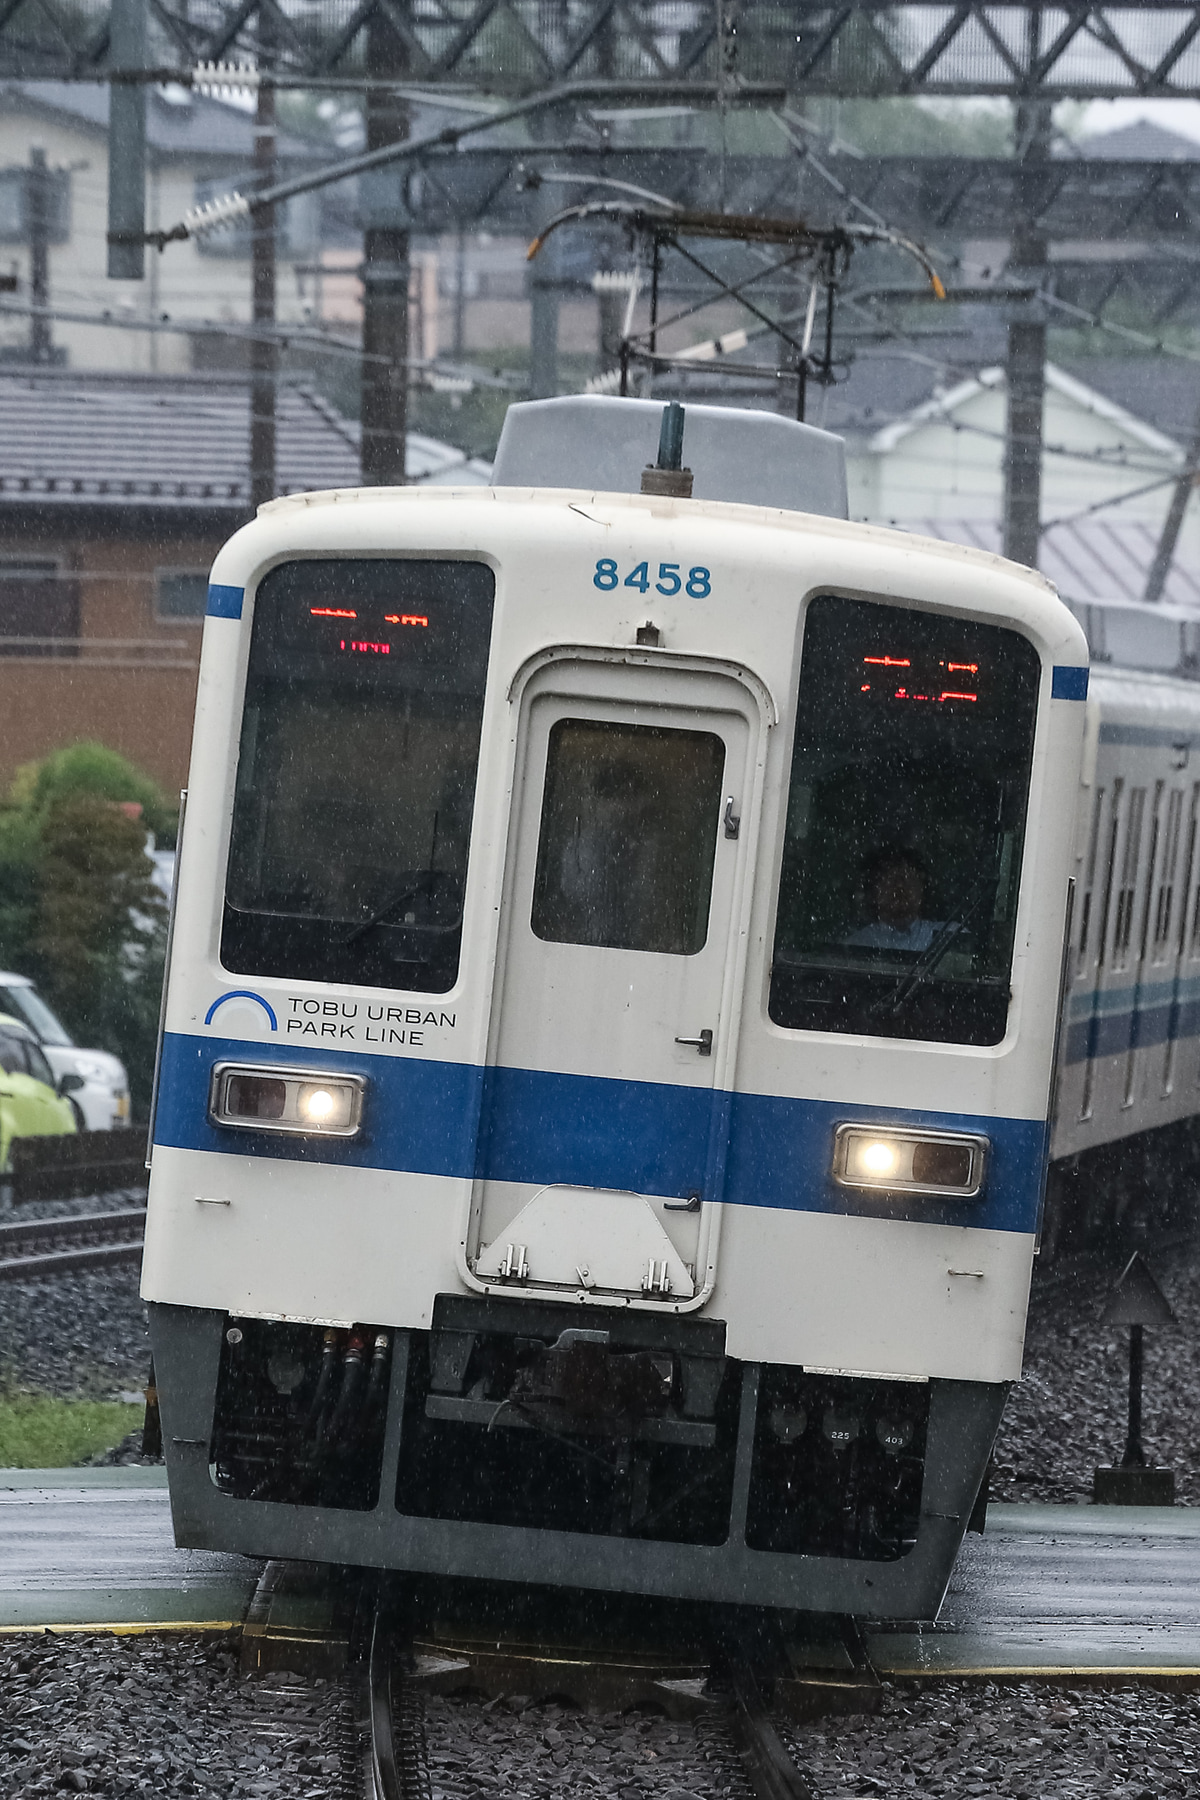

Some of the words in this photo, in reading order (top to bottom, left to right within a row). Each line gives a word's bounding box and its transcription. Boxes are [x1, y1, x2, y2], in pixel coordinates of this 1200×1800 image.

[593, 558, 711, 599] 8458
[288, 998, 358, 1018] TOBU
[367, 1005, 457, 1028] URBAN
[287, 1019, 356, 1039] PARK
[365, 1026, 425, 1046] LINE
[831, 1431, 850, 1440] 225
[885, 1436, 903, 1445] 403
